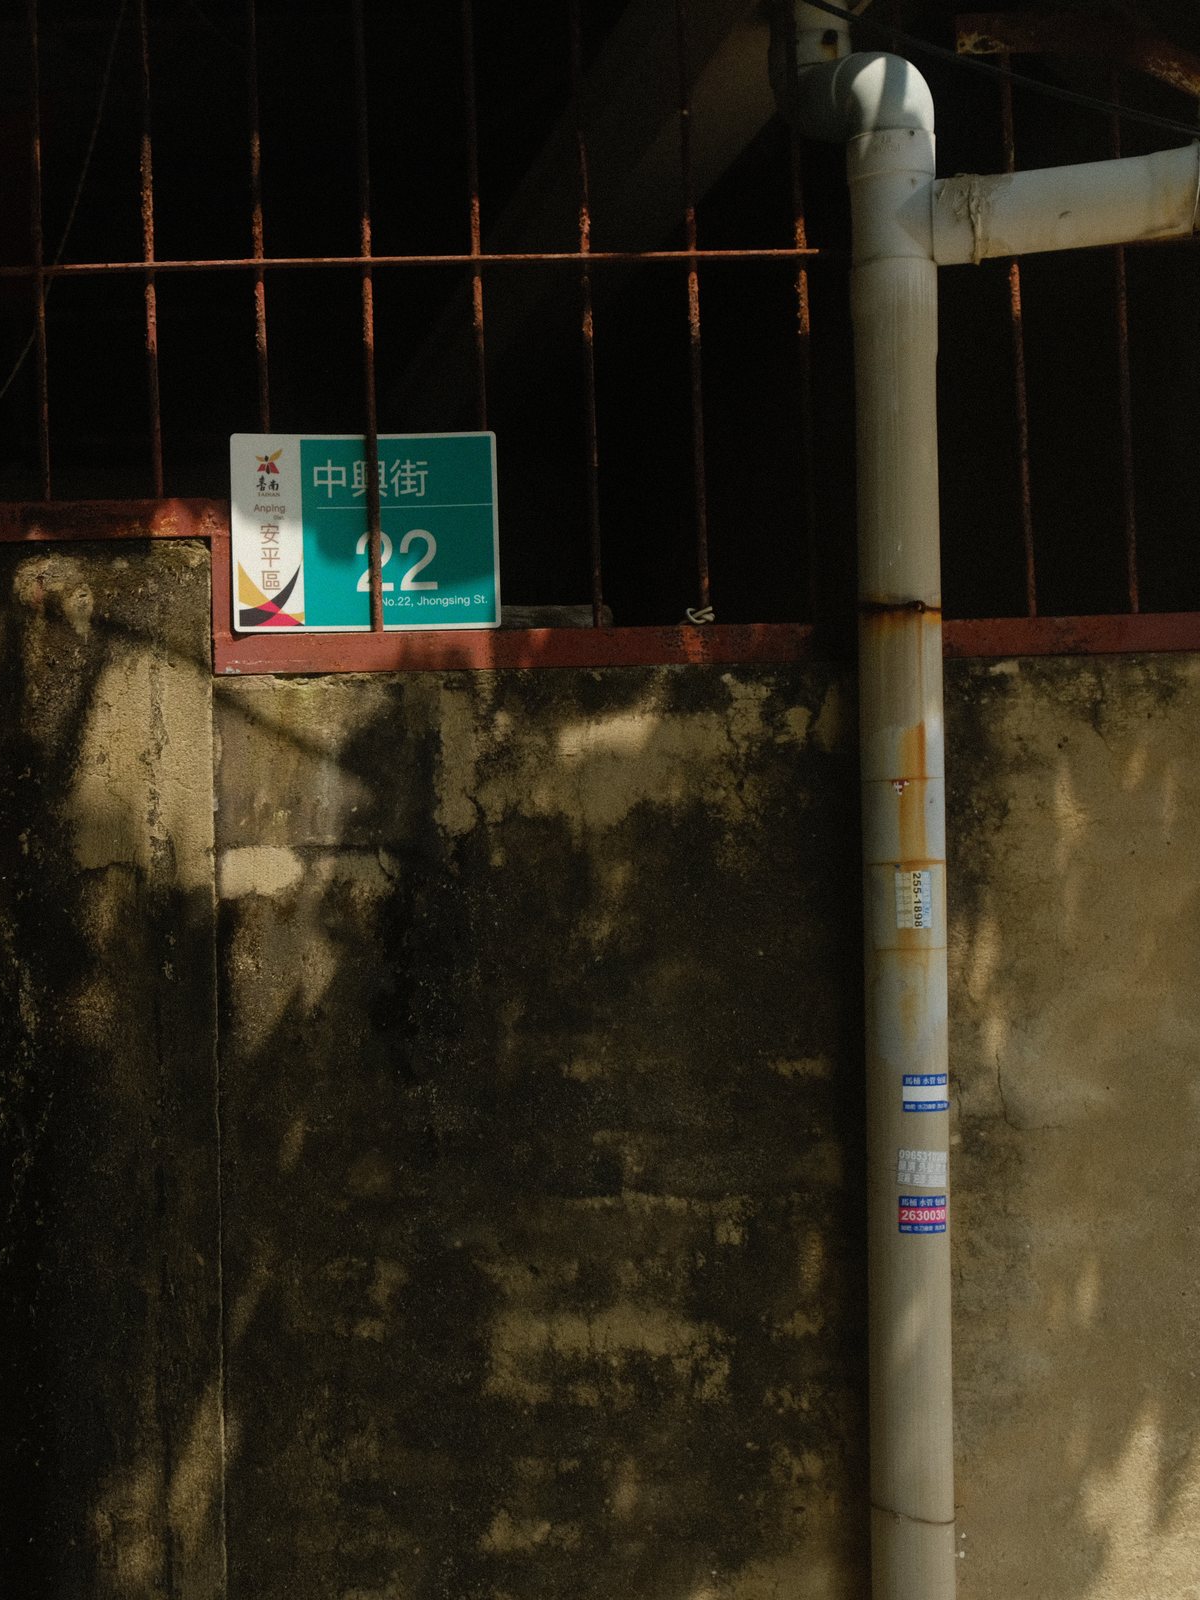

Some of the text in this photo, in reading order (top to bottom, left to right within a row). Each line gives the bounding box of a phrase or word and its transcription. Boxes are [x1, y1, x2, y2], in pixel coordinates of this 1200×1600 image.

[312, 458, 429, 499] 中興街
[254, 503, 286, 514] Anping
[259, 523, 282, 591] 安平區
[355, 528, 439, 593] 22
[417, 595, 471, 607] Jhongsing
[473, 594, 488, 604] St.
[912, 872, 923, 928] 255-1898
[901, 1209, 946, 1221] 2630030
